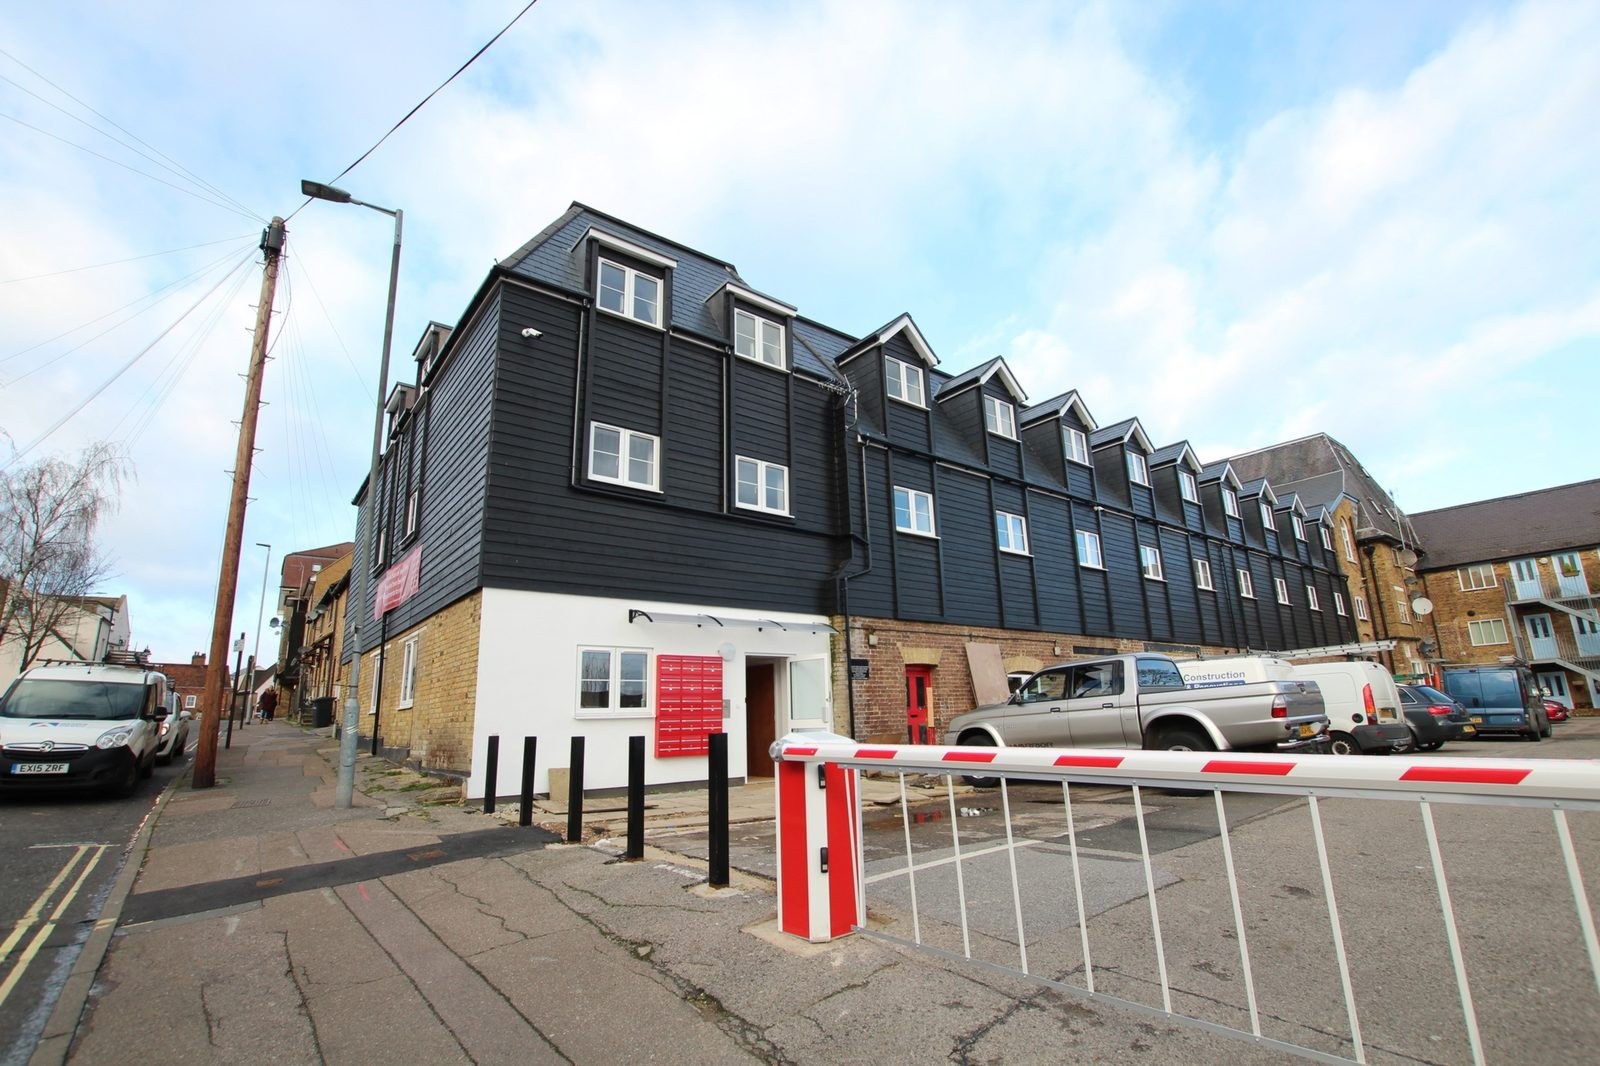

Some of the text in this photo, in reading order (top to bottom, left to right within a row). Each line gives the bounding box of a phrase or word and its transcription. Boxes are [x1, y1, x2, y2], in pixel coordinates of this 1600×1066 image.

[1184, 671, 1245, 681] Construction
[20, 764, 64, 773] EX15 ZRF
